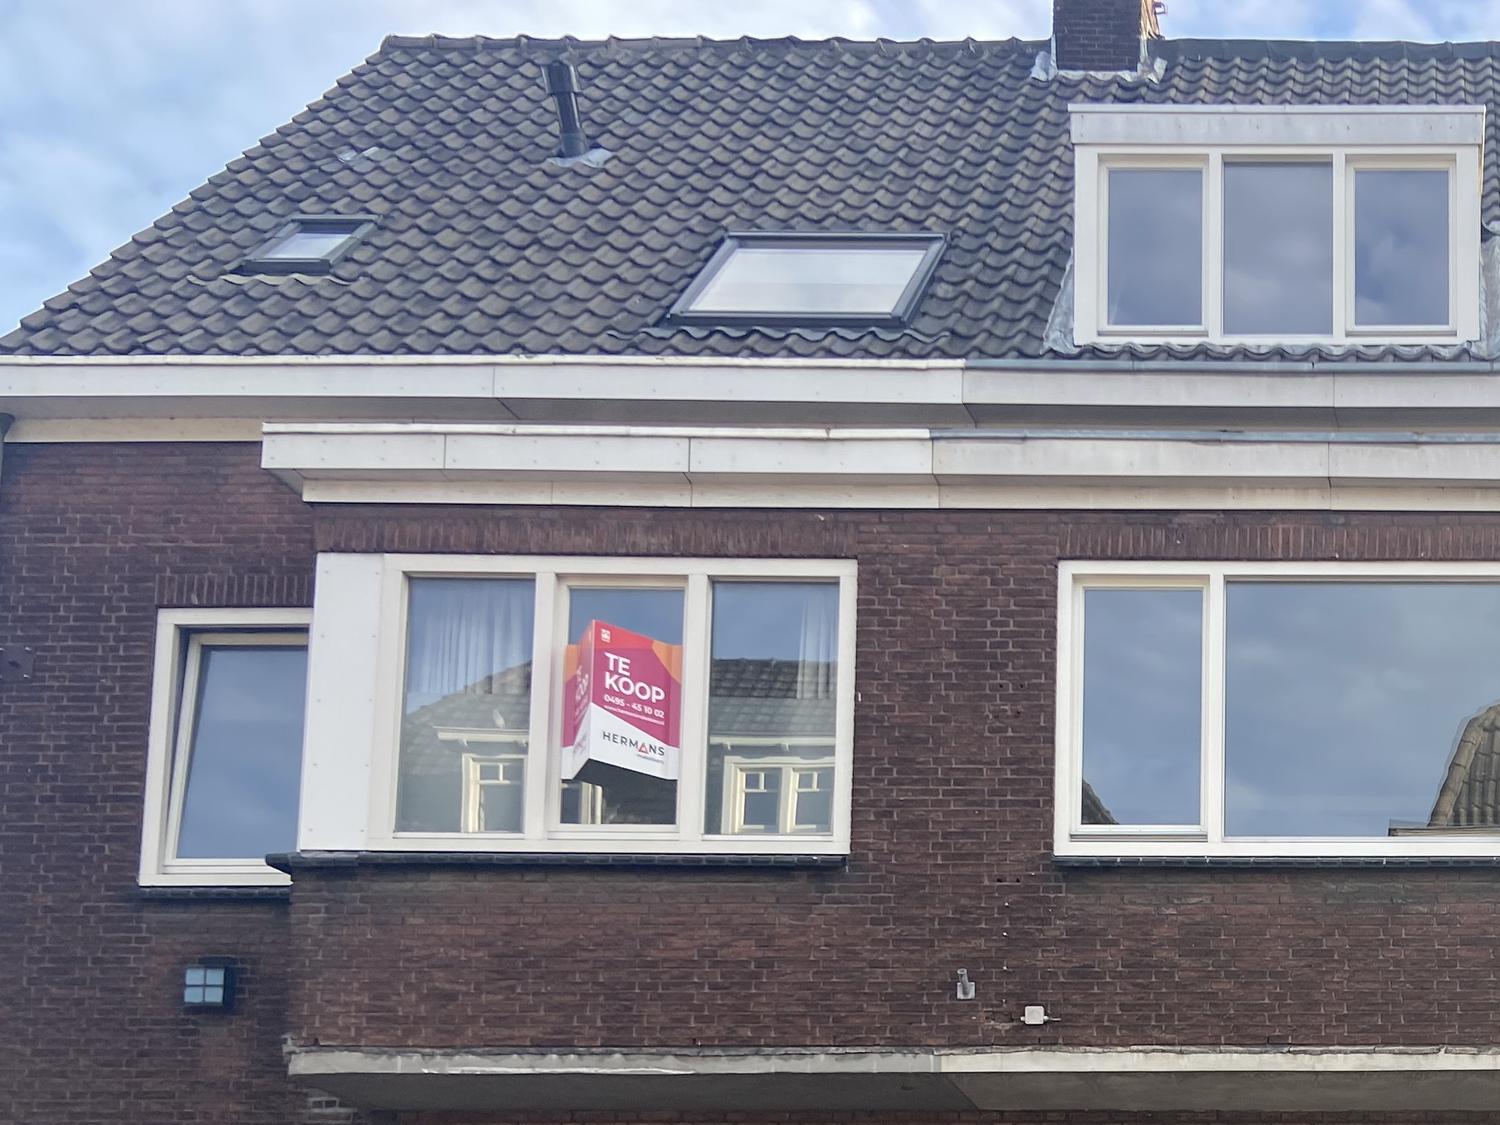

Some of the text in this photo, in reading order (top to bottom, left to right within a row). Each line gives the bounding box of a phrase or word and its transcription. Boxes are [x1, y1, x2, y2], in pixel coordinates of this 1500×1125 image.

[604, 652, 631, 677] TE
[604, 672, 666, 704] KOOP
[602, 731, 665, 757] HERMANS
